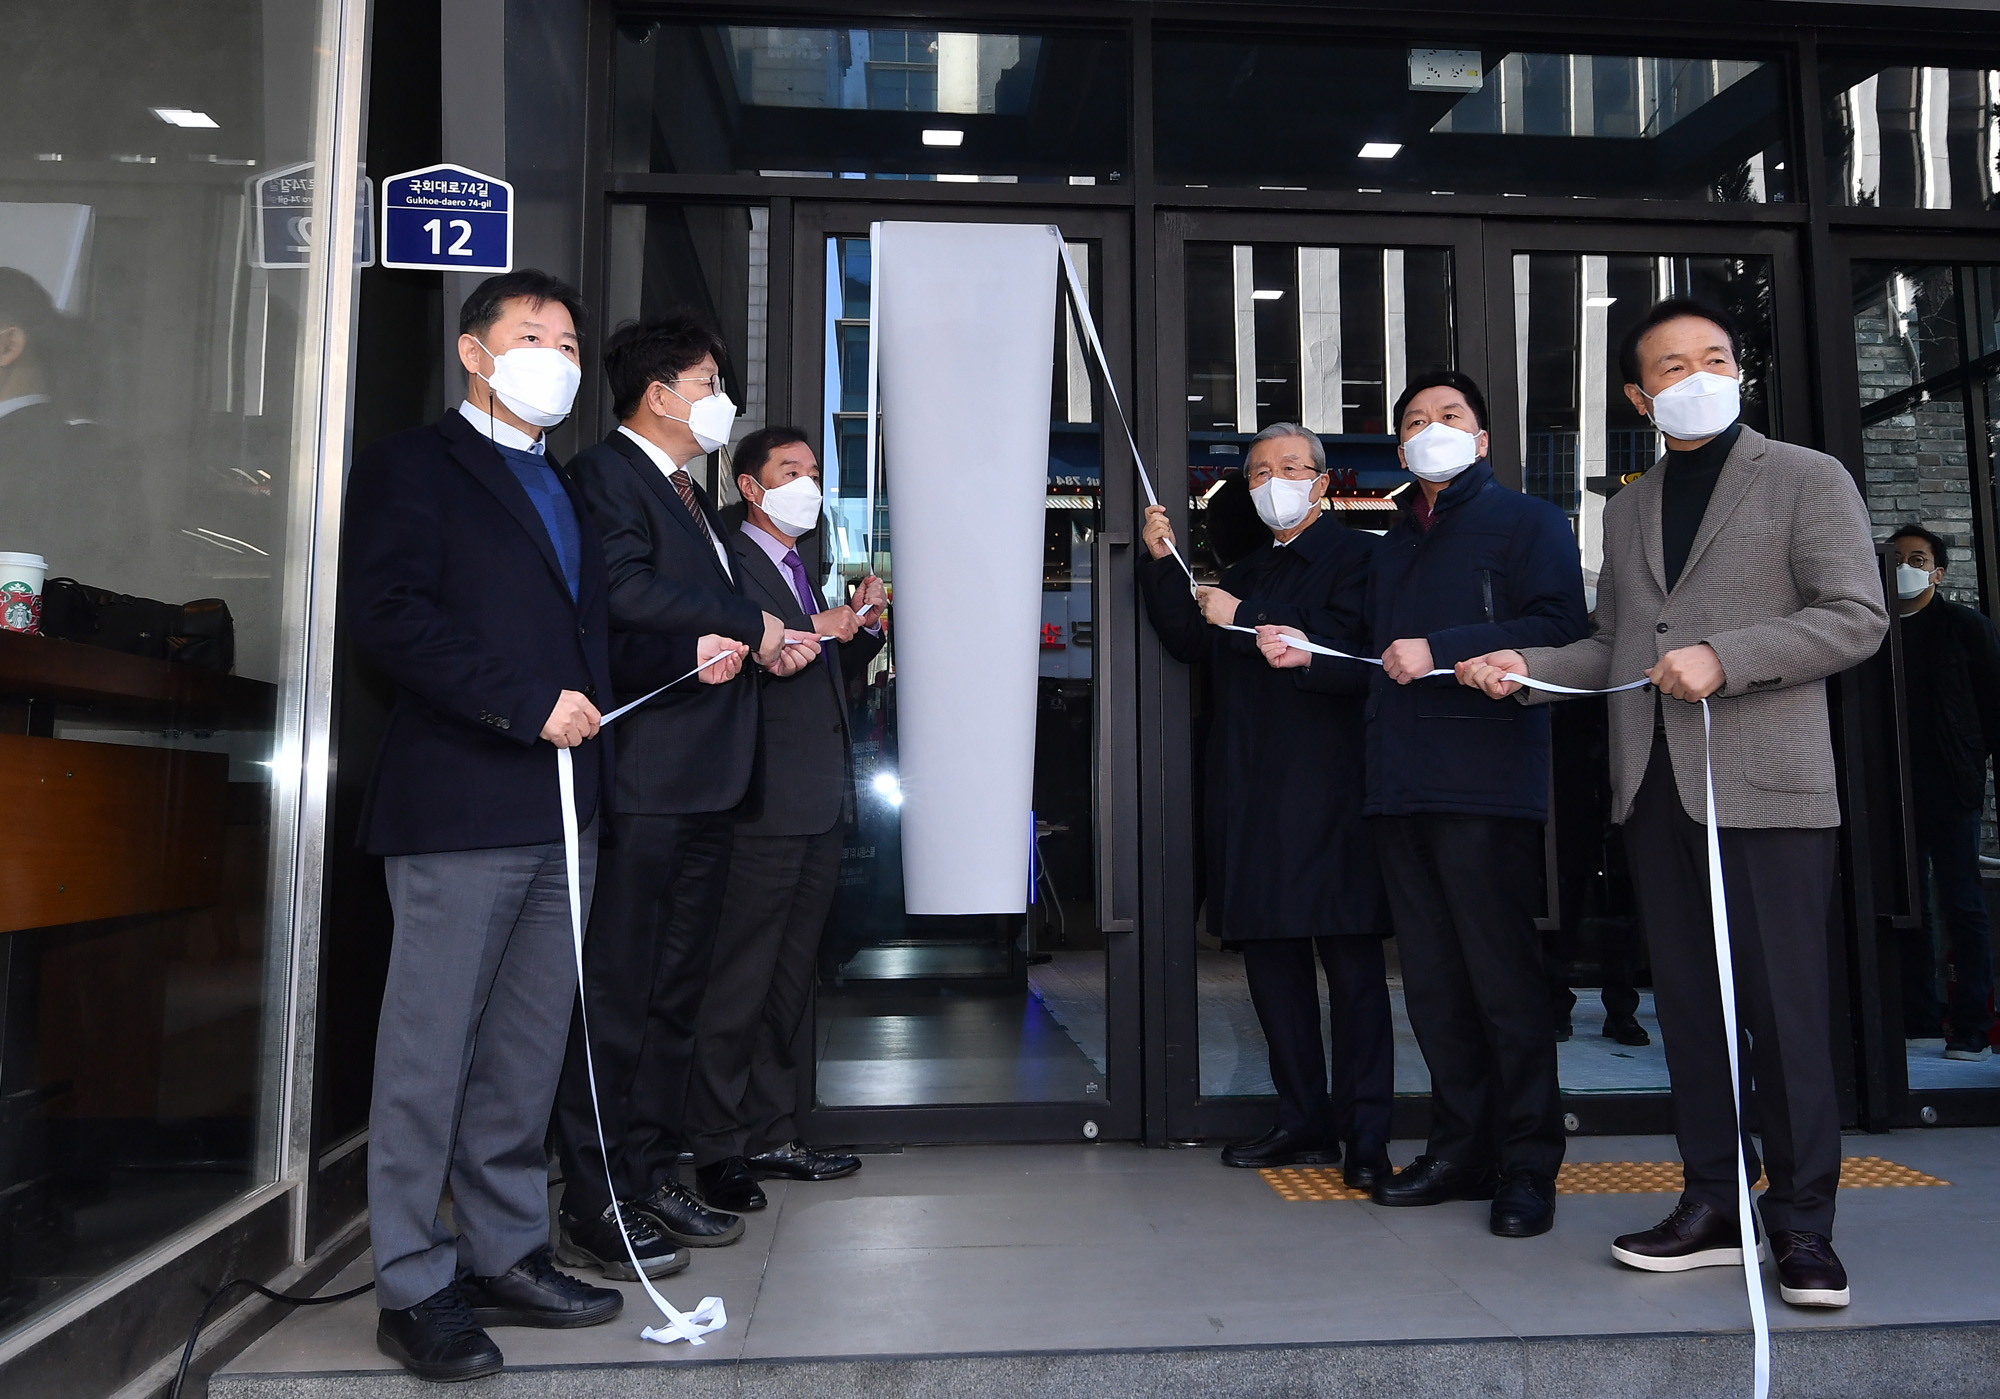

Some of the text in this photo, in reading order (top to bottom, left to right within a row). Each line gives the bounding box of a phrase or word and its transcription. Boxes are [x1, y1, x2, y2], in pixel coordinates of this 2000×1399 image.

[408, 180, 489, 198] 국회대로74길
[406, 196, 492, 209] Gukhoe-daero 74-gil
[423, 218, 473, 257] 12
